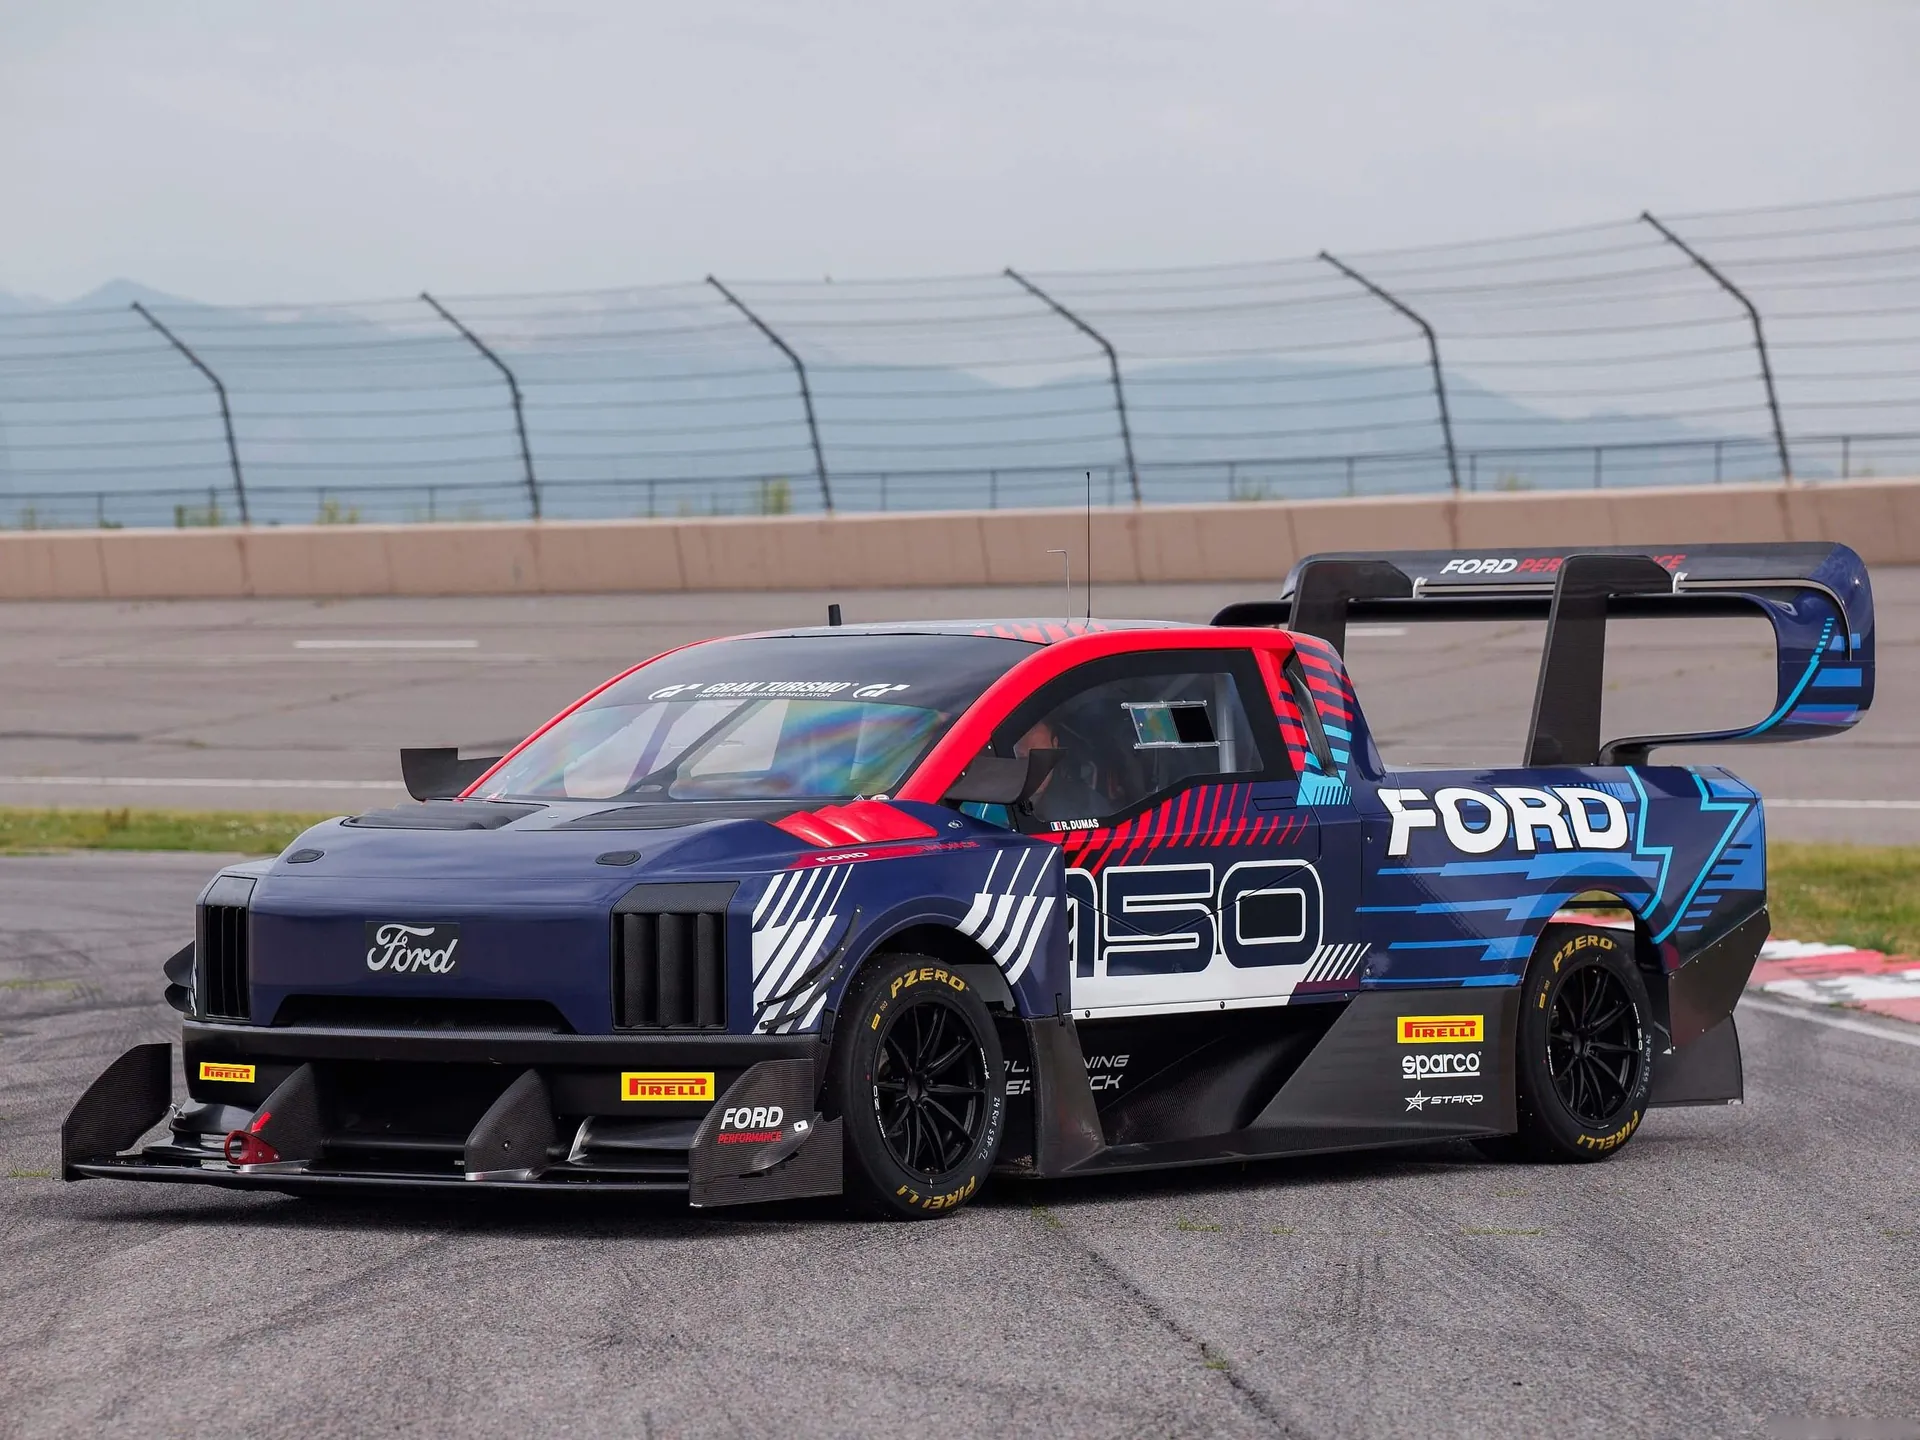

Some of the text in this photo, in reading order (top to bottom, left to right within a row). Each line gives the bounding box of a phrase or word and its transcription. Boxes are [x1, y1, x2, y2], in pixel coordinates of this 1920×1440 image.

[1439, 558, 1518, 574] FORD
[702, 681, 765, 693] GRAN
[759, 681, 851, 693] TURISMO
[1377, 787, 1629, 856] FORD
[815, 851, 869, 863] FORD
[366, 923, 458, 974] Ford
[1404, 1020, 1476, 1039] PIRELLI
[204, 1066, 251, 1080] PIRELLI
[1402, 1052, 1480, 1080] sparco
[629, 1078, 707, 1096] PIRELLI
[1430, 1094, 1484, 1106] STARD
[720, 1106, 784, 1130] FORD
[717, 1130, 782, 1144] PERFORMANCE
